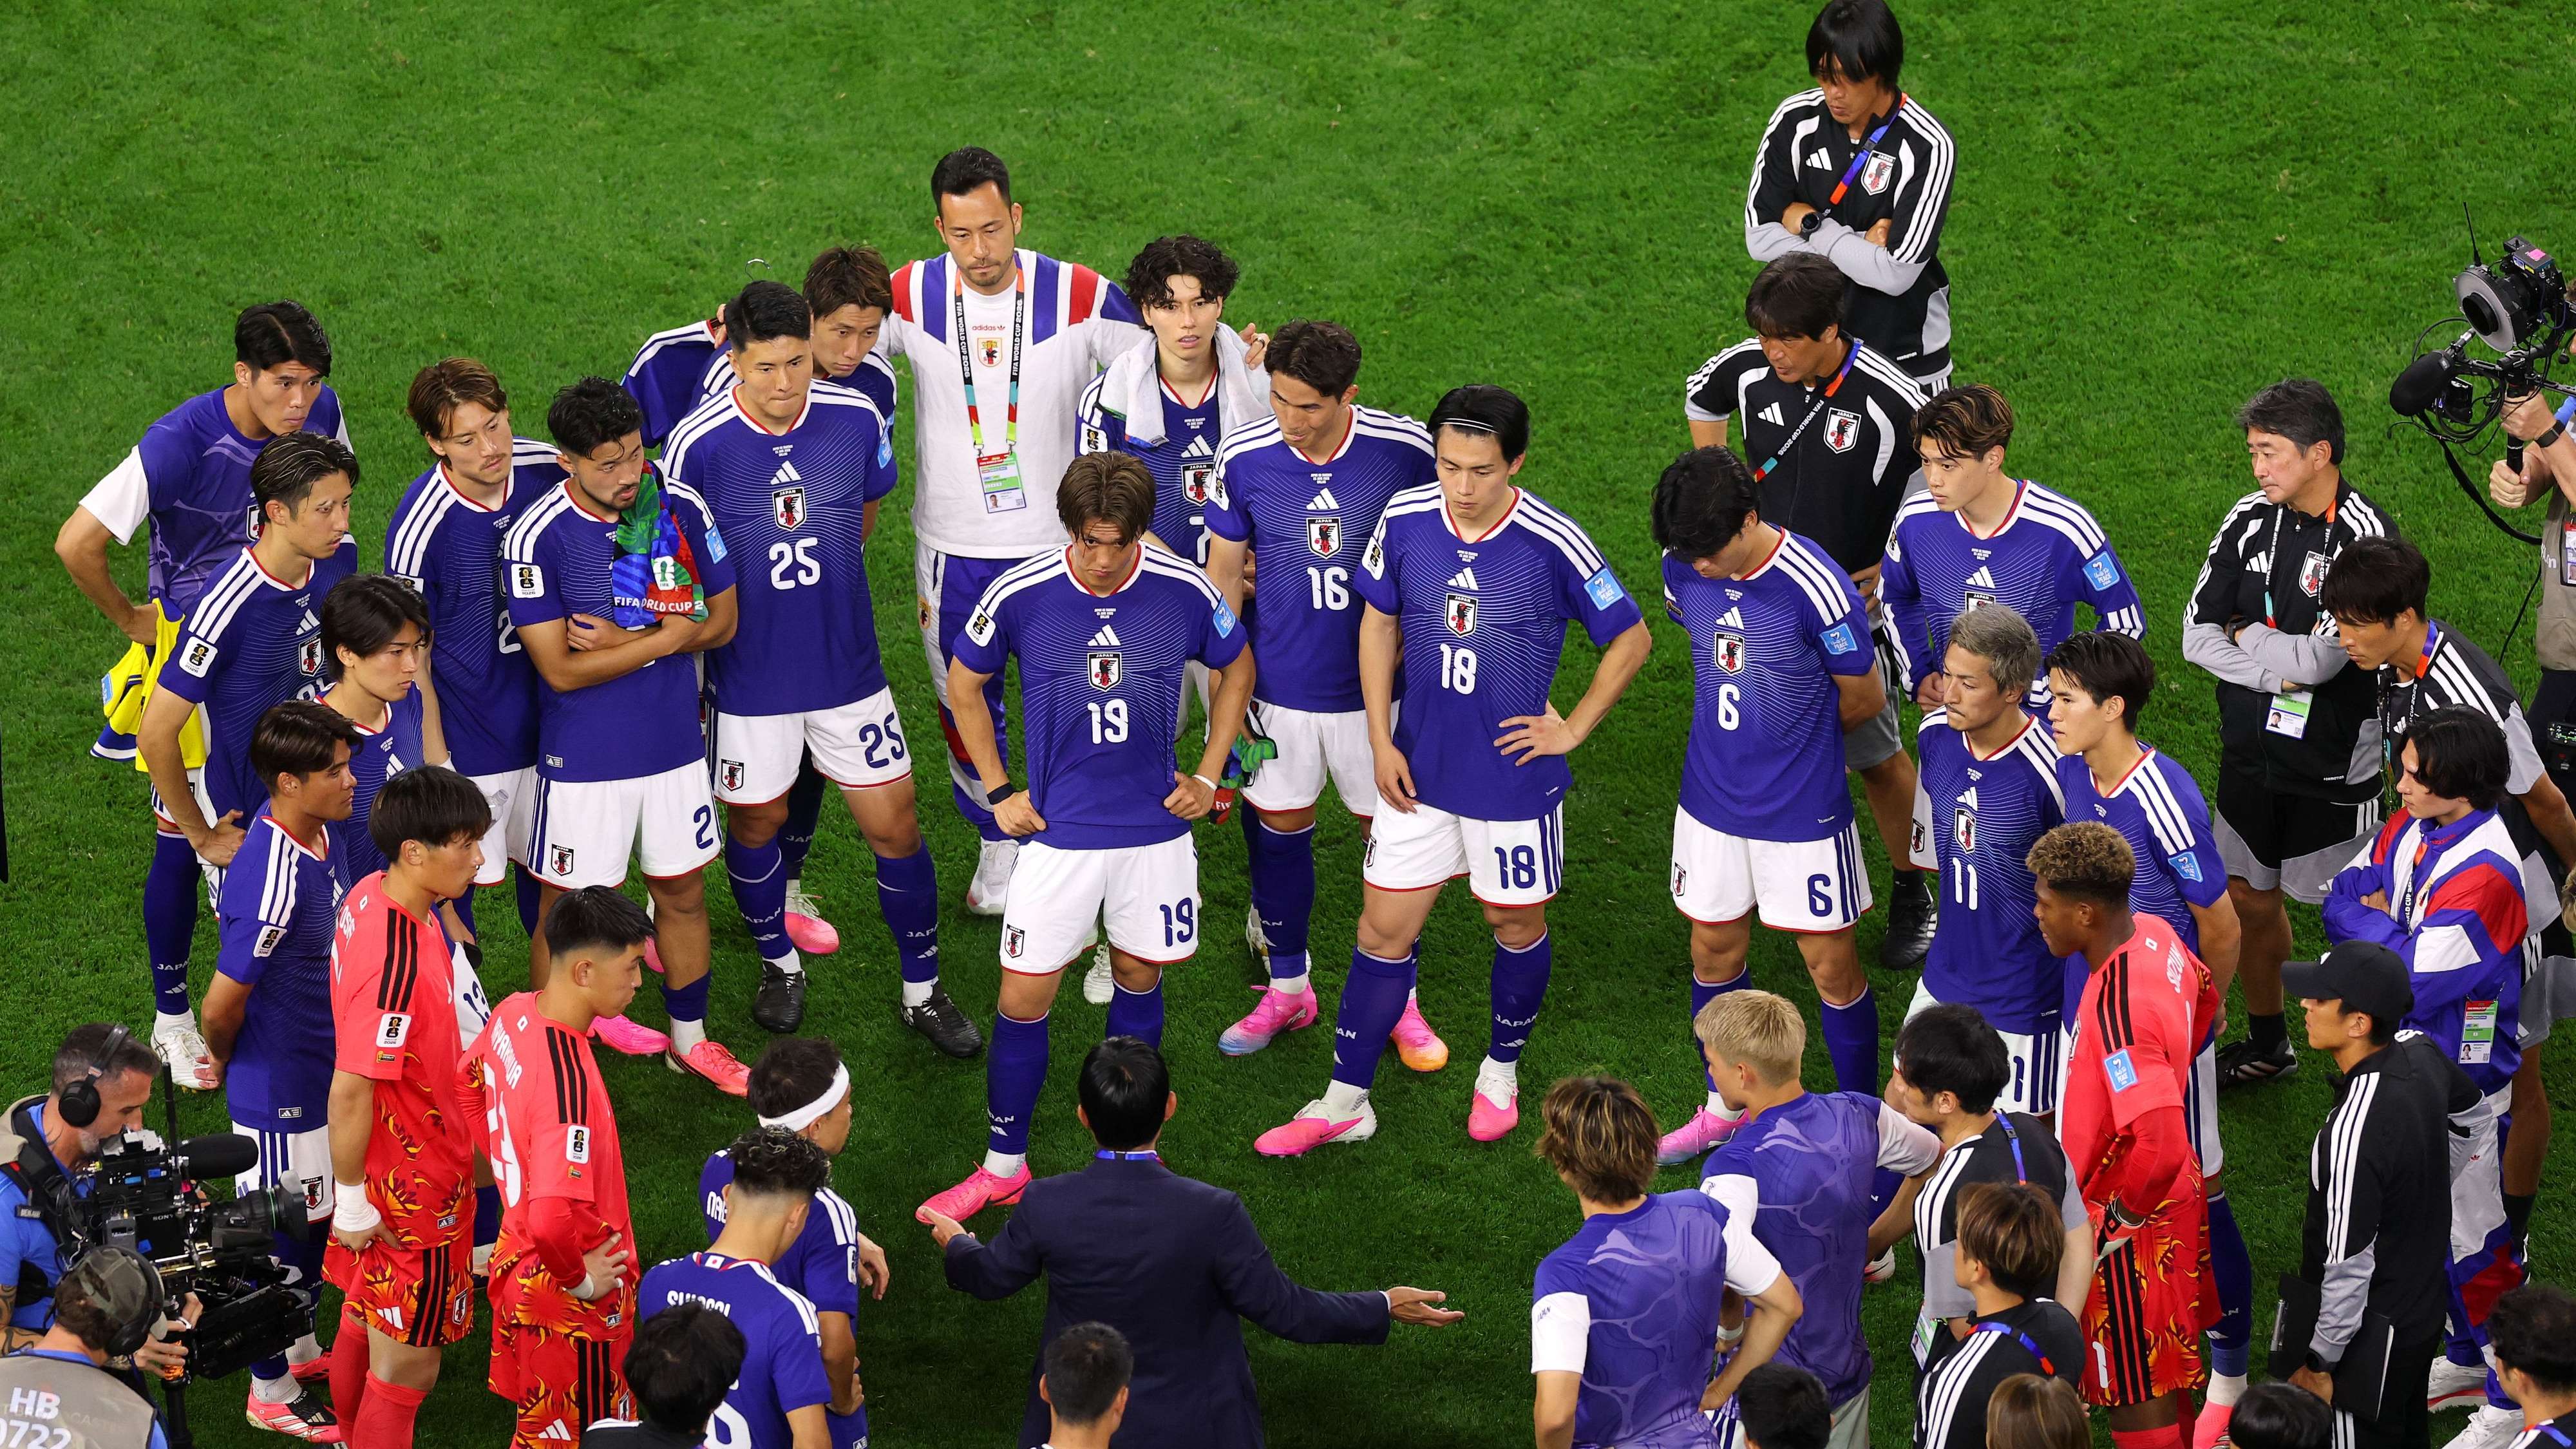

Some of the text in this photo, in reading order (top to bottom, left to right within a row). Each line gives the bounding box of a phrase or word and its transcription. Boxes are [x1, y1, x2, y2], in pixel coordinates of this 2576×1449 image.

[957, 316, 966, 341] WORLD
[1777, 399, 1824, 455] FIFA WORLD CUP 2026
[1837, 410, 1854, 419] JAPAN
[769, 537, 820, 590] 25
[614, 596, 640, 608] FIFA
[668, 600, 692, 611] CUP
[1307, 566, 1349, 611] 16
[1440, 643, 1477, 695] 18
[1087, 699, 1128, 744] 19
[1718, 683, 1740, 731] 6
[859, 712, 905, 768] 25
[694, 805, 714, 849] 2
[1494, 845, 1535, 889] 18
[1952, 857, 1978, 911] 11
[1808, 874, 1833, 917] 6
[1160, 897, 1194, 947] 19
[2092, 1341, 2108, 1388] 1
[10, 1387, 61, 1420] HB
